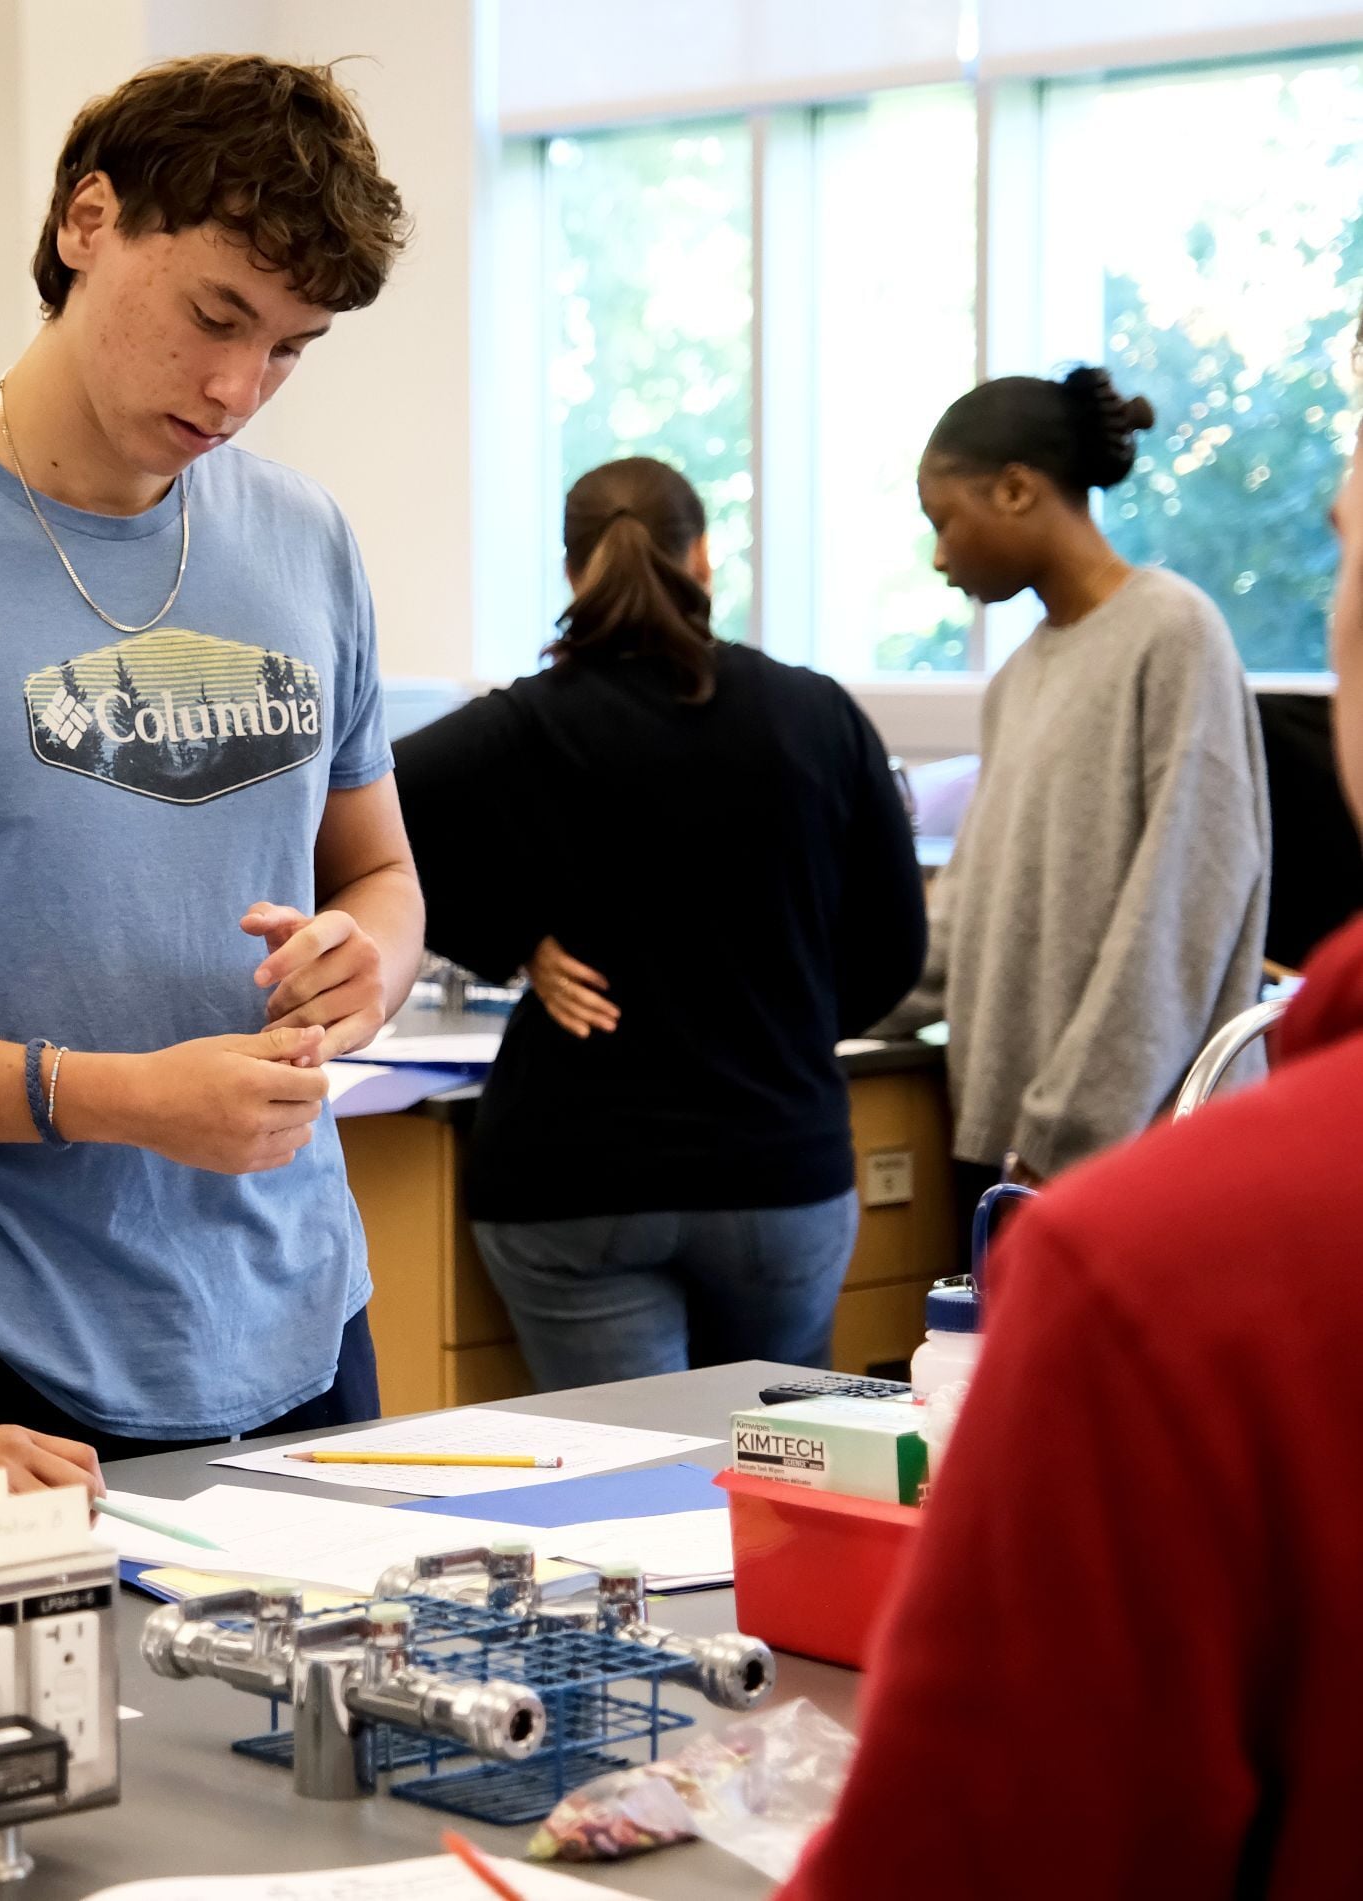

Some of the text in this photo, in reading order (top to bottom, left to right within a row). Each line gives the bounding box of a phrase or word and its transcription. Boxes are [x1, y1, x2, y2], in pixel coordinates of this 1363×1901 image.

[94, 684, 319, 744] Columbia
[736, 1420, 771, 1432] Kimwipes
[736, 1432, 824, 1460] KIMTECH
